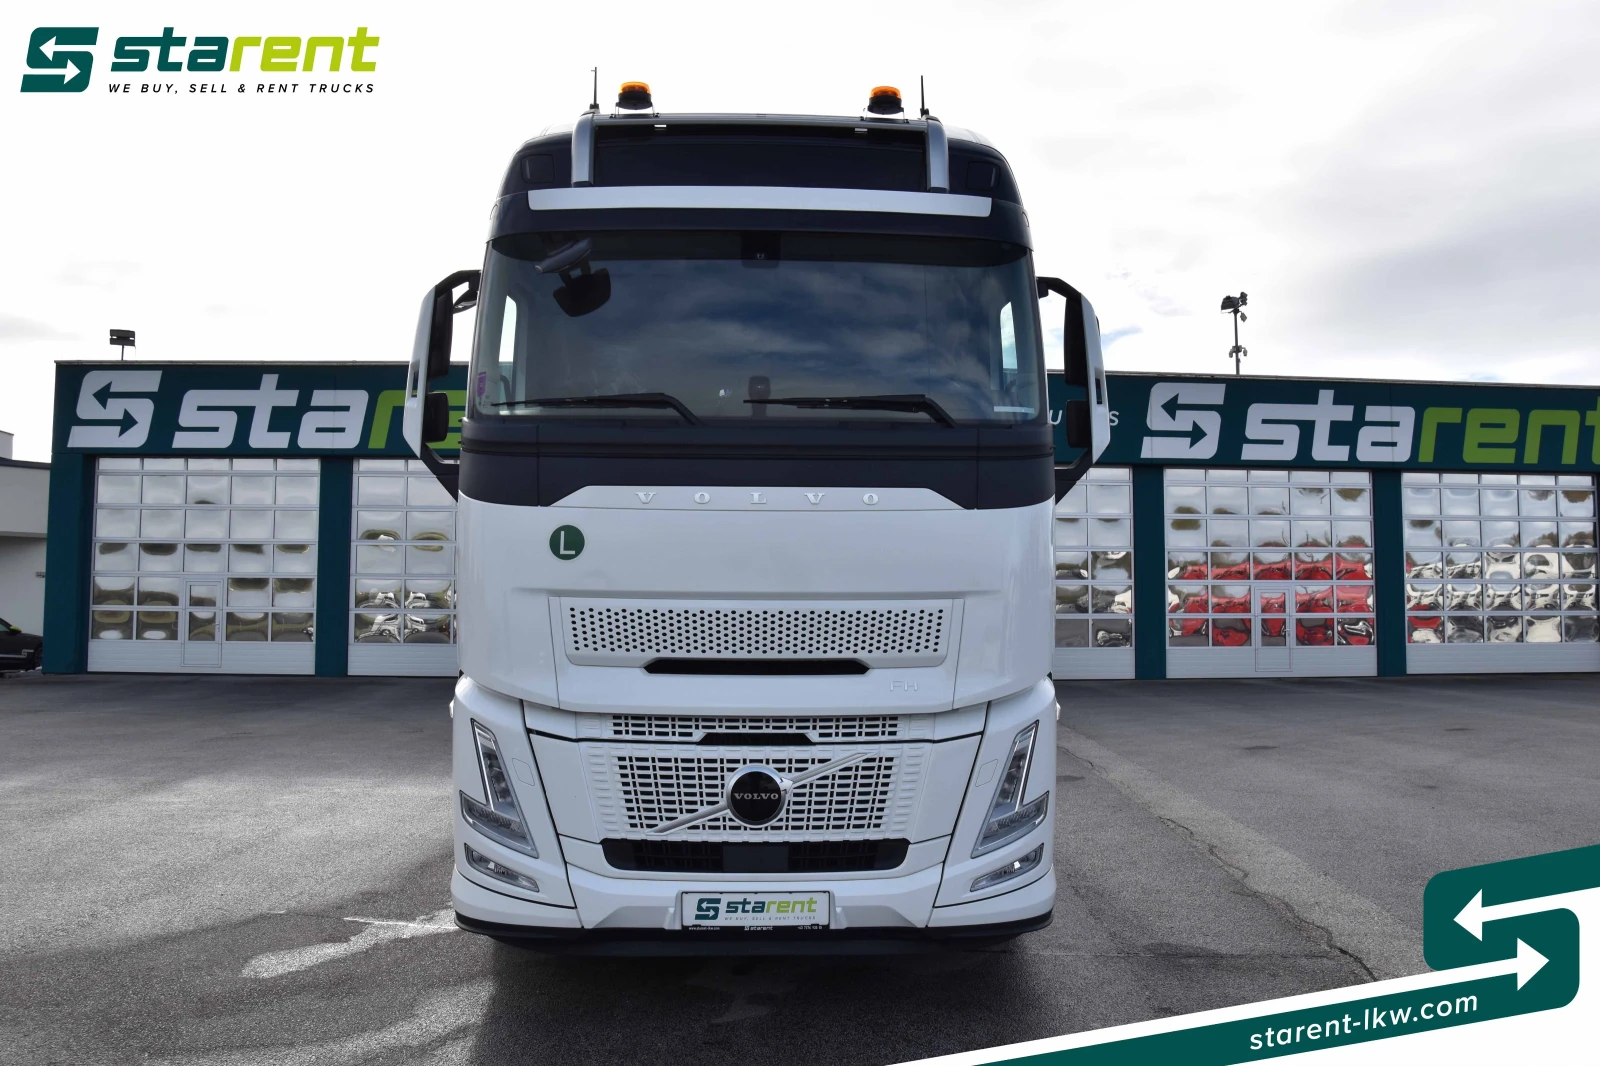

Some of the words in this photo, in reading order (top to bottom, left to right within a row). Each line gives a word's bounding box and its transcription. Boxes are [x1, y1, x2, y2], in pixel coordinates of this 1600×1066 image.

[171, 374, 467, 449] star
[635, 491, 879, 506] VOLVO
[559, 530, 576, 555] L
[889, 680, 918, 692] FH
[733, 792, 779, 800] VOLVO
[725, 897, 818, 914] starent
